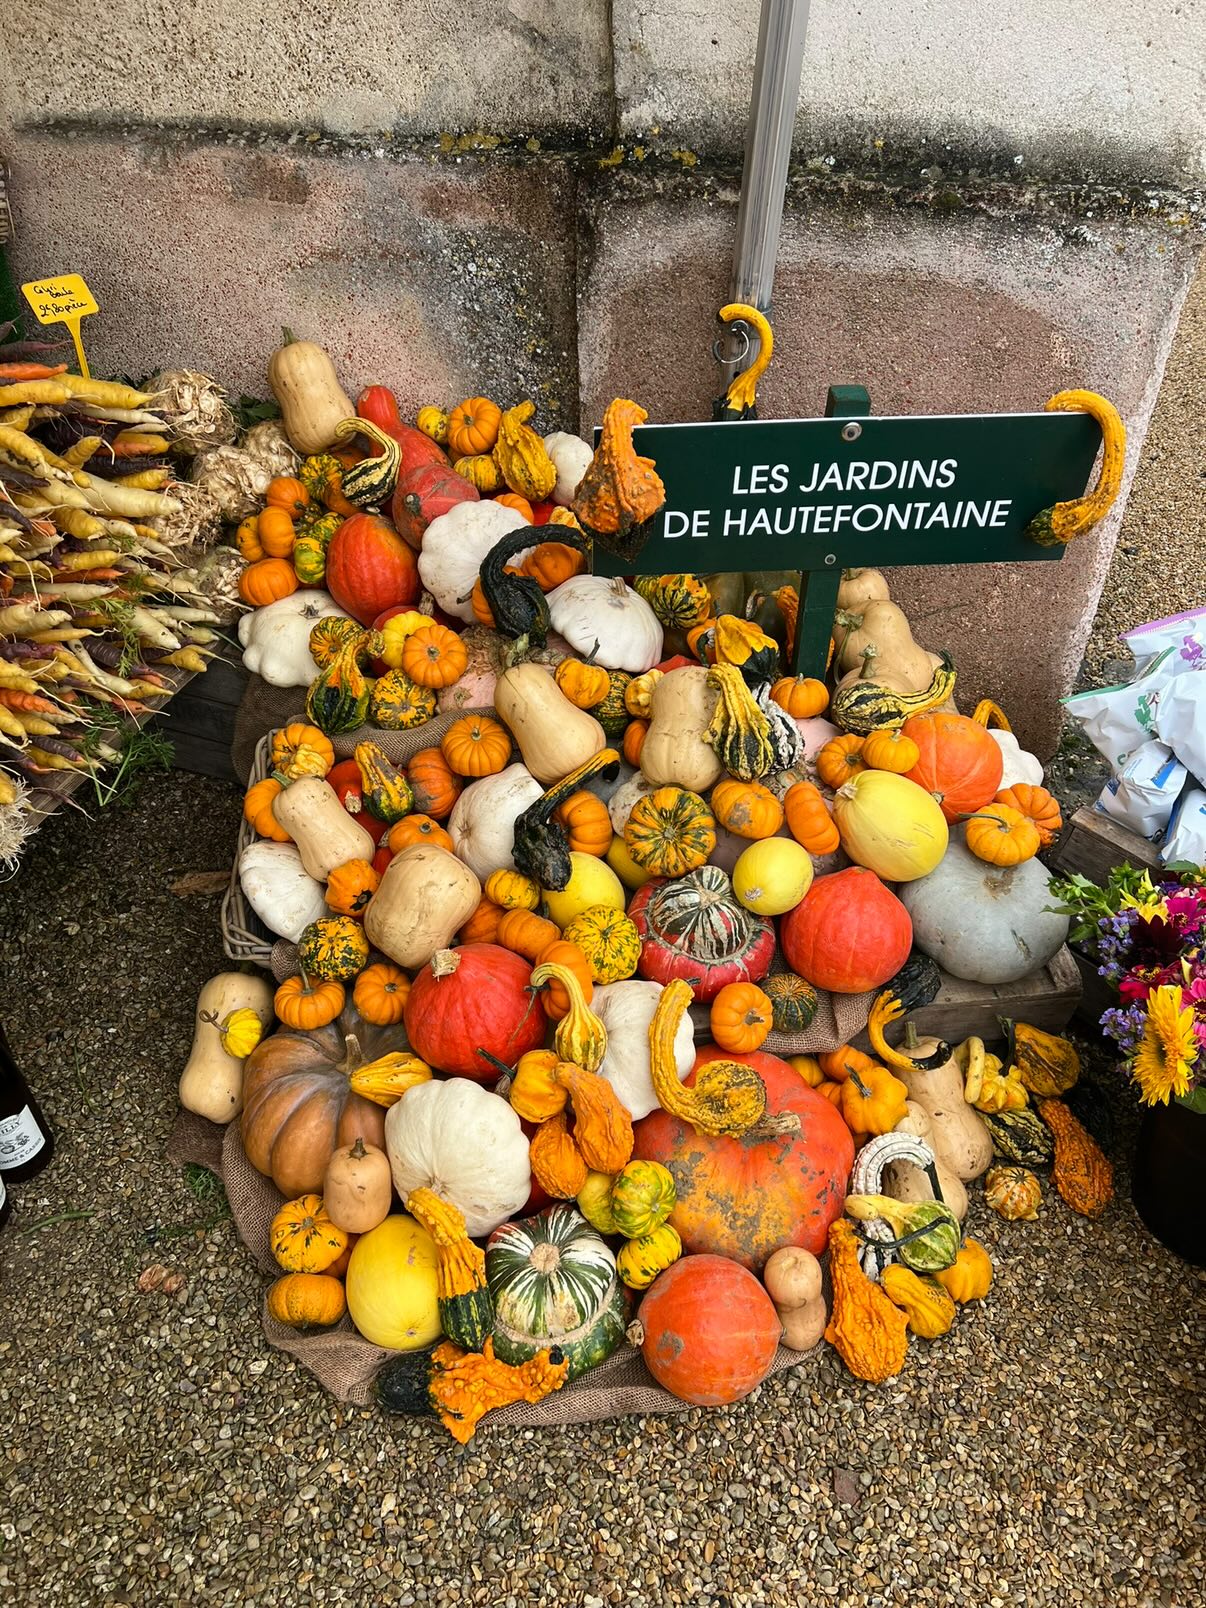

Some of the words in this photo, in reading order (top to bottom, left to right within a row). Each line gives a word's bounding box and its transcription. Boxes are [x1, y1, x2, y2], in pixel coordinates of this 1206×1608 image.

[732, 463, 789, 495] LES
[798, 458, 958, 493] JARDINS
[663, 510, 711, 539] DE
[722, 499, 1013, 537] HAUTEFONTAINE
